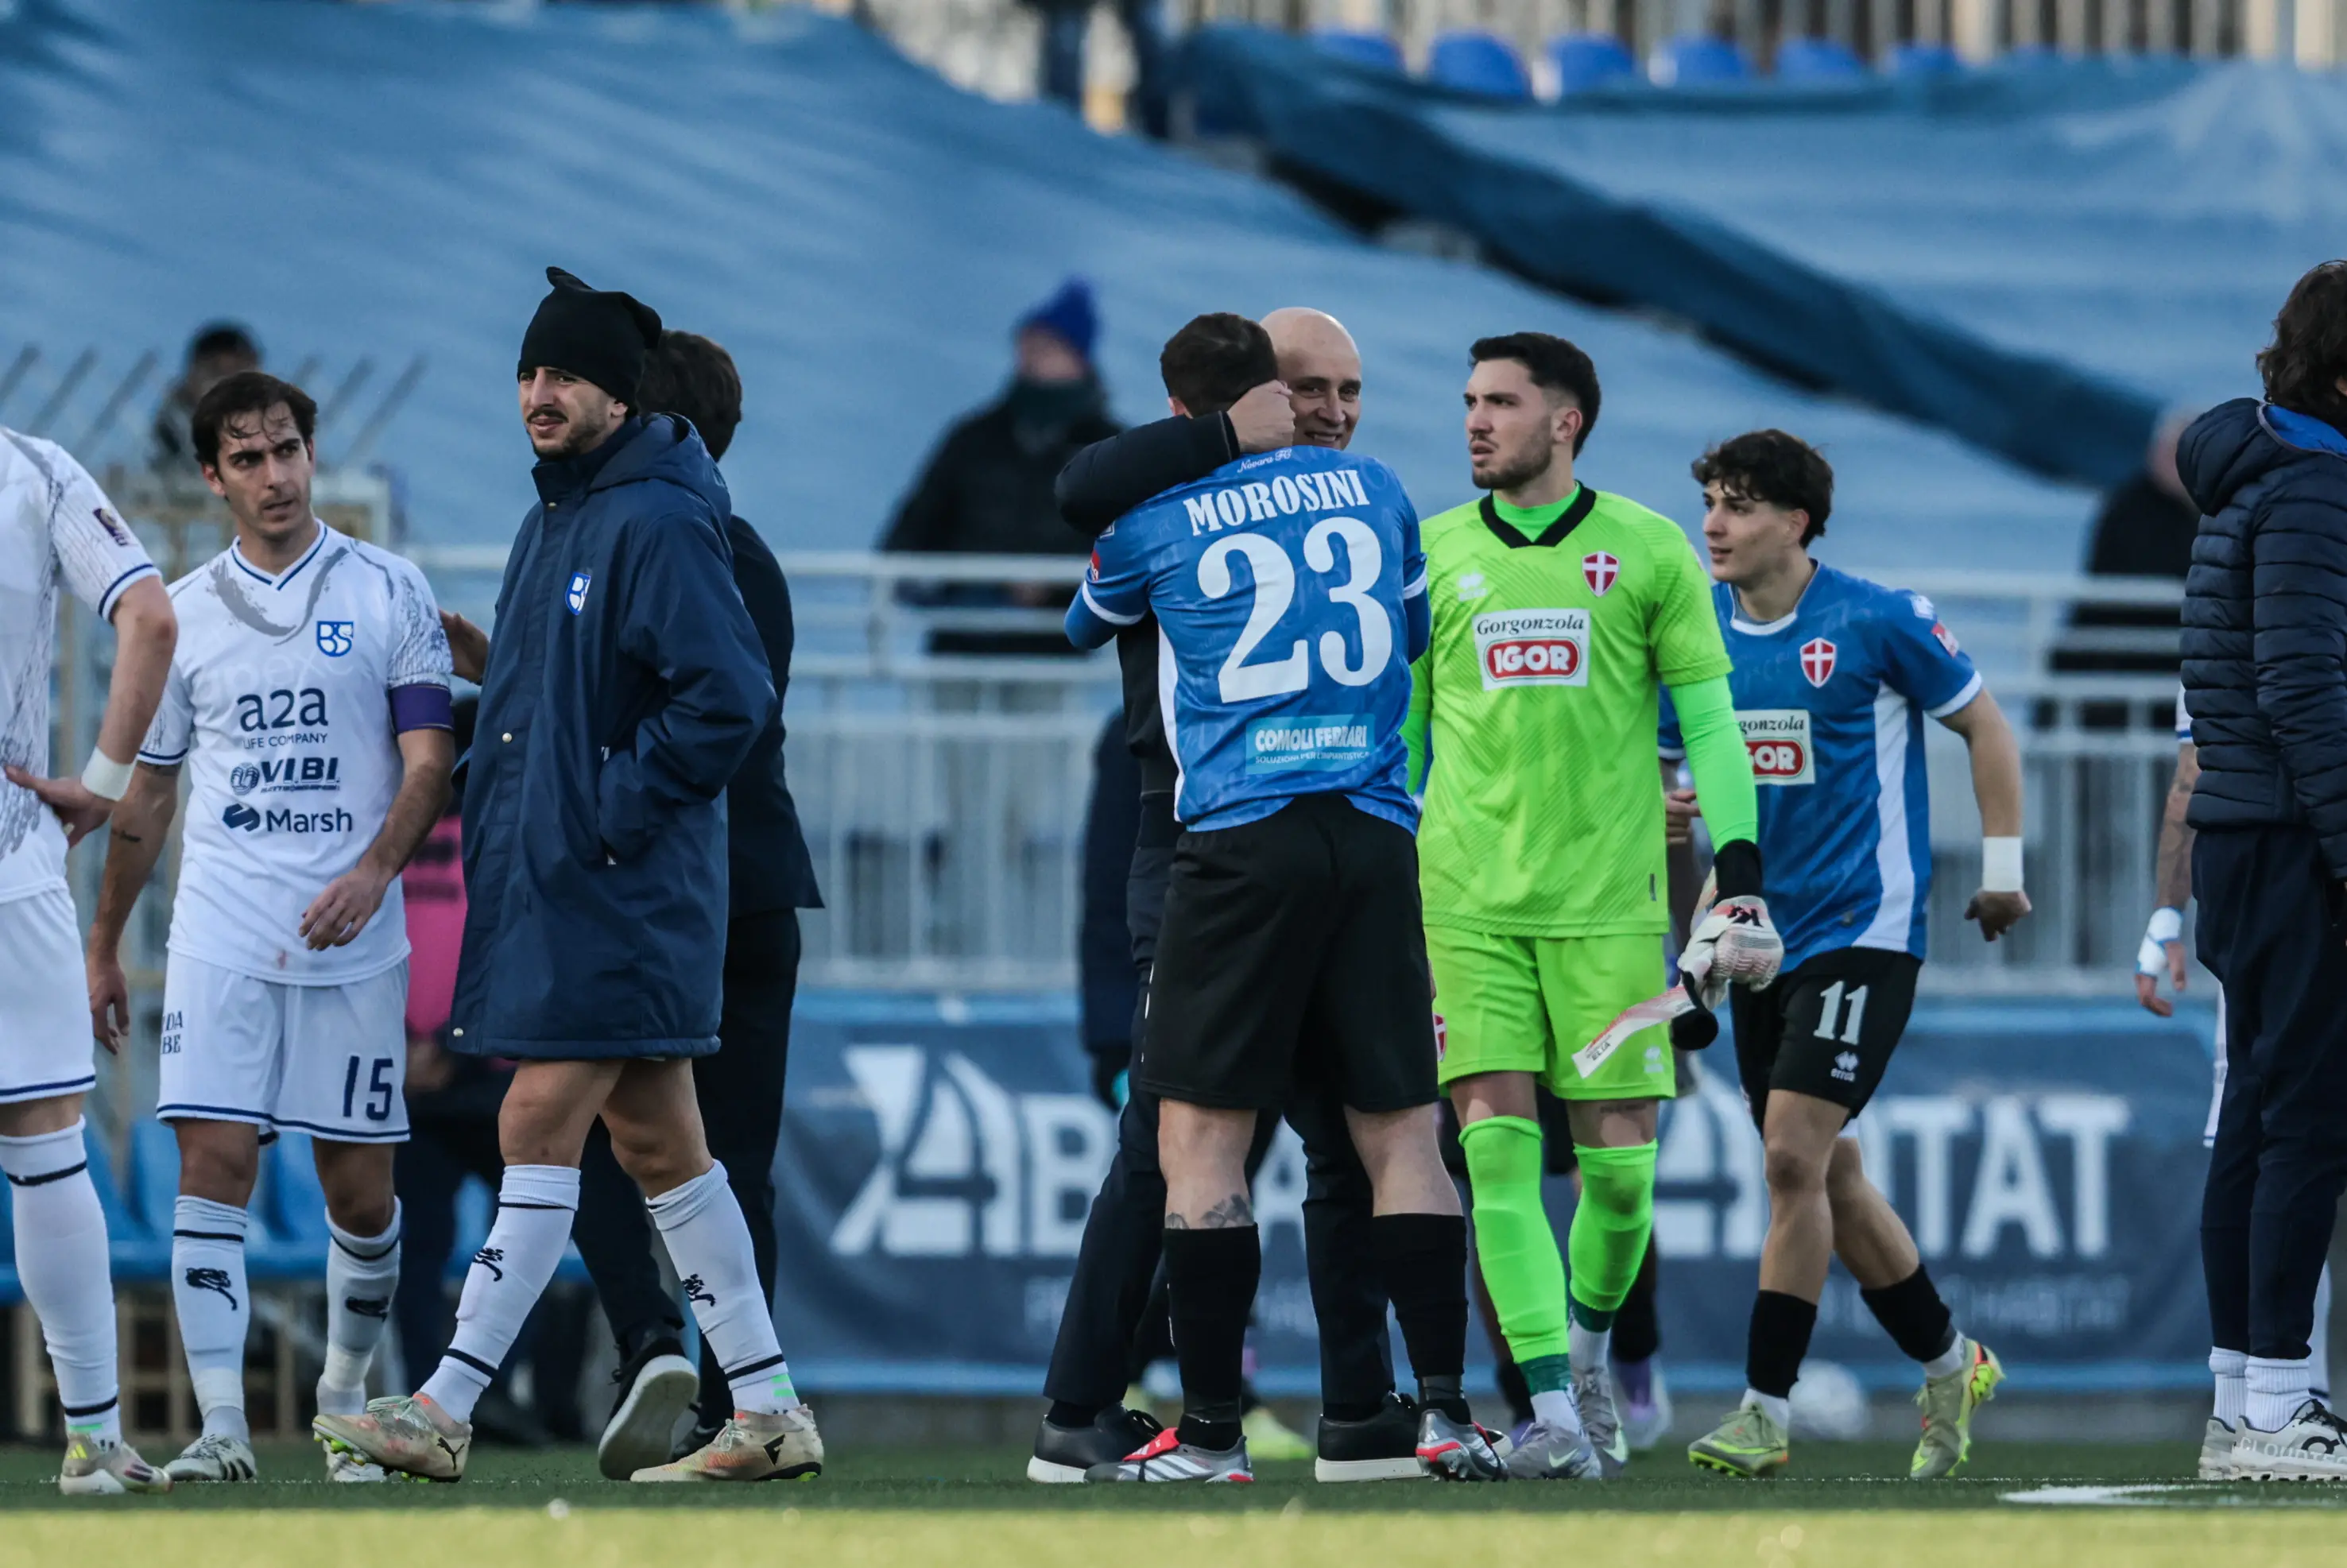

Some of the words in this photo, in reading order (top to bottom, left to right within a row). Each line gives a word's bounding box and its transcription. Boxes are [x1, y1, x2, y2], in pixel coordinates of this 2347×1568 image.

[1237, 459, 1273, 473] Novara
[1275, 448, 1292, 461] FC
[1183, 470, 1370, 536] MOROSINI
[1198, 517, 1392, 703] 23
[1477, 614, 1584, 635] Gorgonzola
[1493, 645, 1570, 674] IGOR
[237, 687, 328, 732] a2a
[1739, 715, 1804, 735] gonzola
[269, 733, 328, 747] COMPANY
[1255, 728, 1314, 752] COMOLI
[1315, 725, 1368, 748] FERRARI
[1748, 745, 1796, 771] OR
[265, 807, 353, 833] Marsh
[162, 1010, 184, 1031] DA
[1813, 980, 1869, 1046] 11
[343, 1055, 394, 1121] 15
